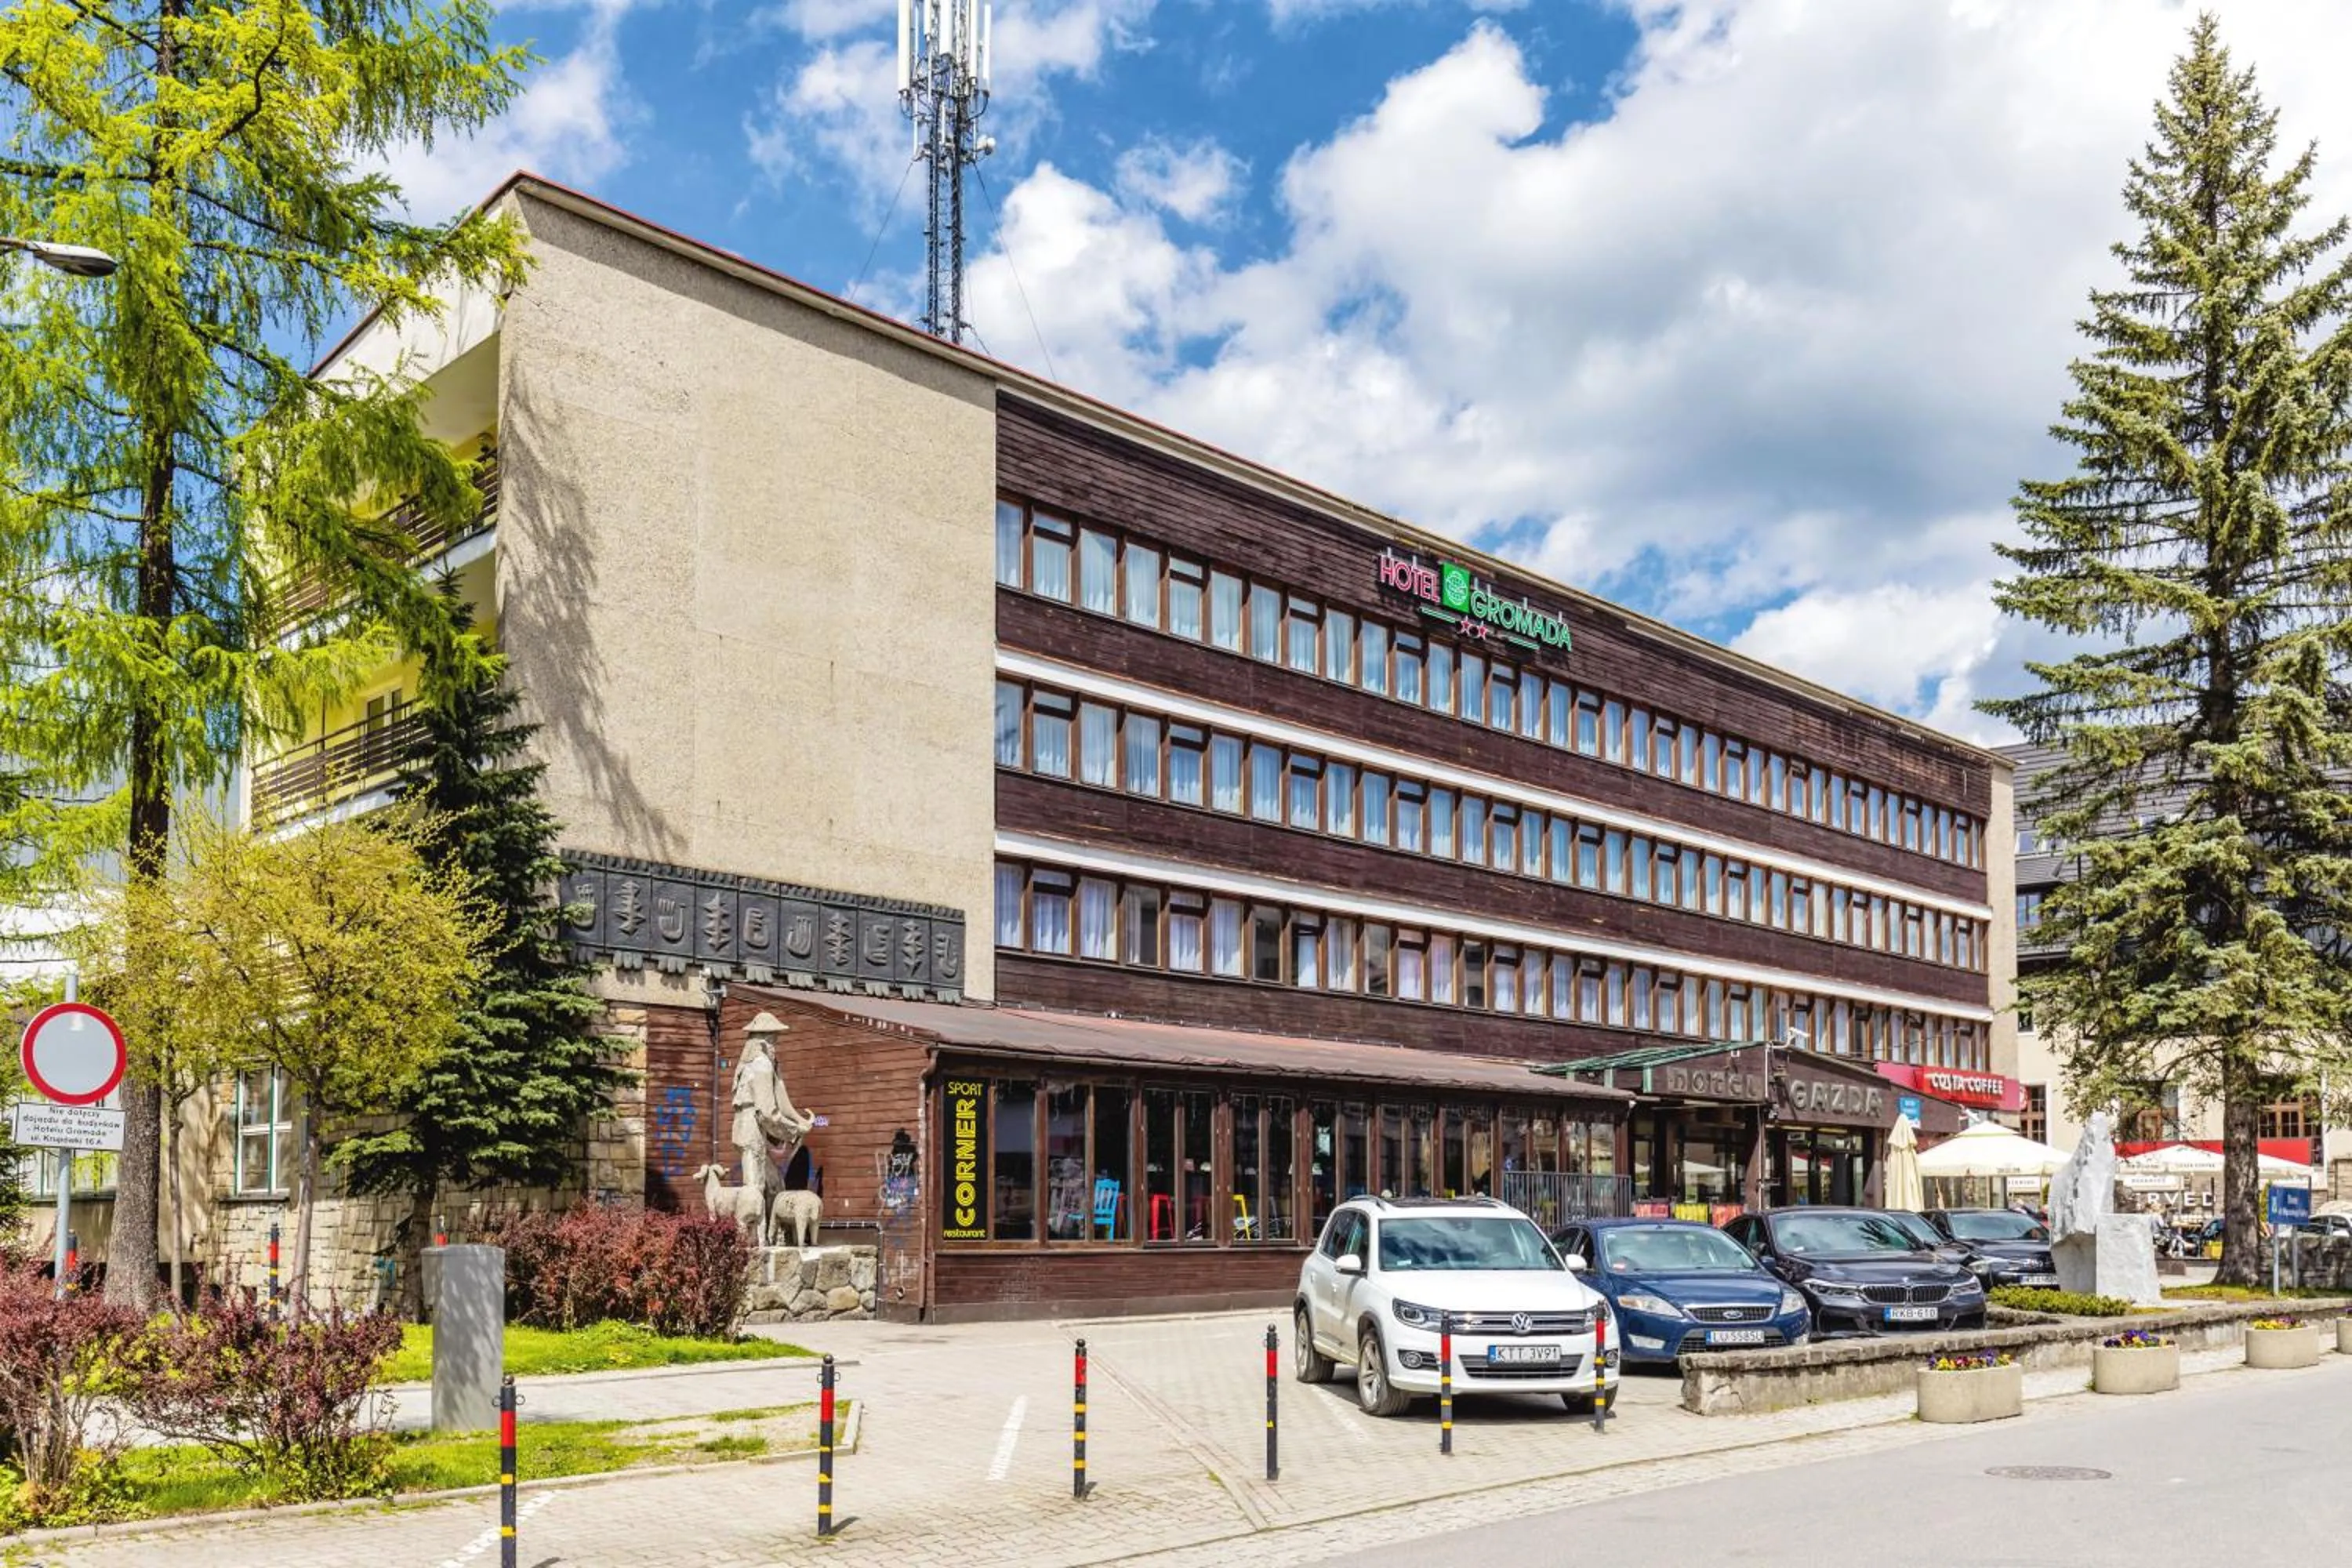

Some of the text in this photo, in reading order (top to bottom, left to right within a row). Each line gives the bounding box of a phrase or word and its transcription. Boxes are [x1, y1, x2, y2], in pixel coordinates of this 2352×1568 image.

[1380, 554, 1573, 652] HOTEL GROMADA
[948, 1081, 983, 1096] SPORT
[1966, 1076, 2004, 1095] COFFEE
[1790, 1080, 1882, 1118] GAZDA
[49, 1106, 64, 1115] Nie
[955, 1098, 976, 1227] CORNER
[1498, 1347, 1557, 1361] KTT 3V91
